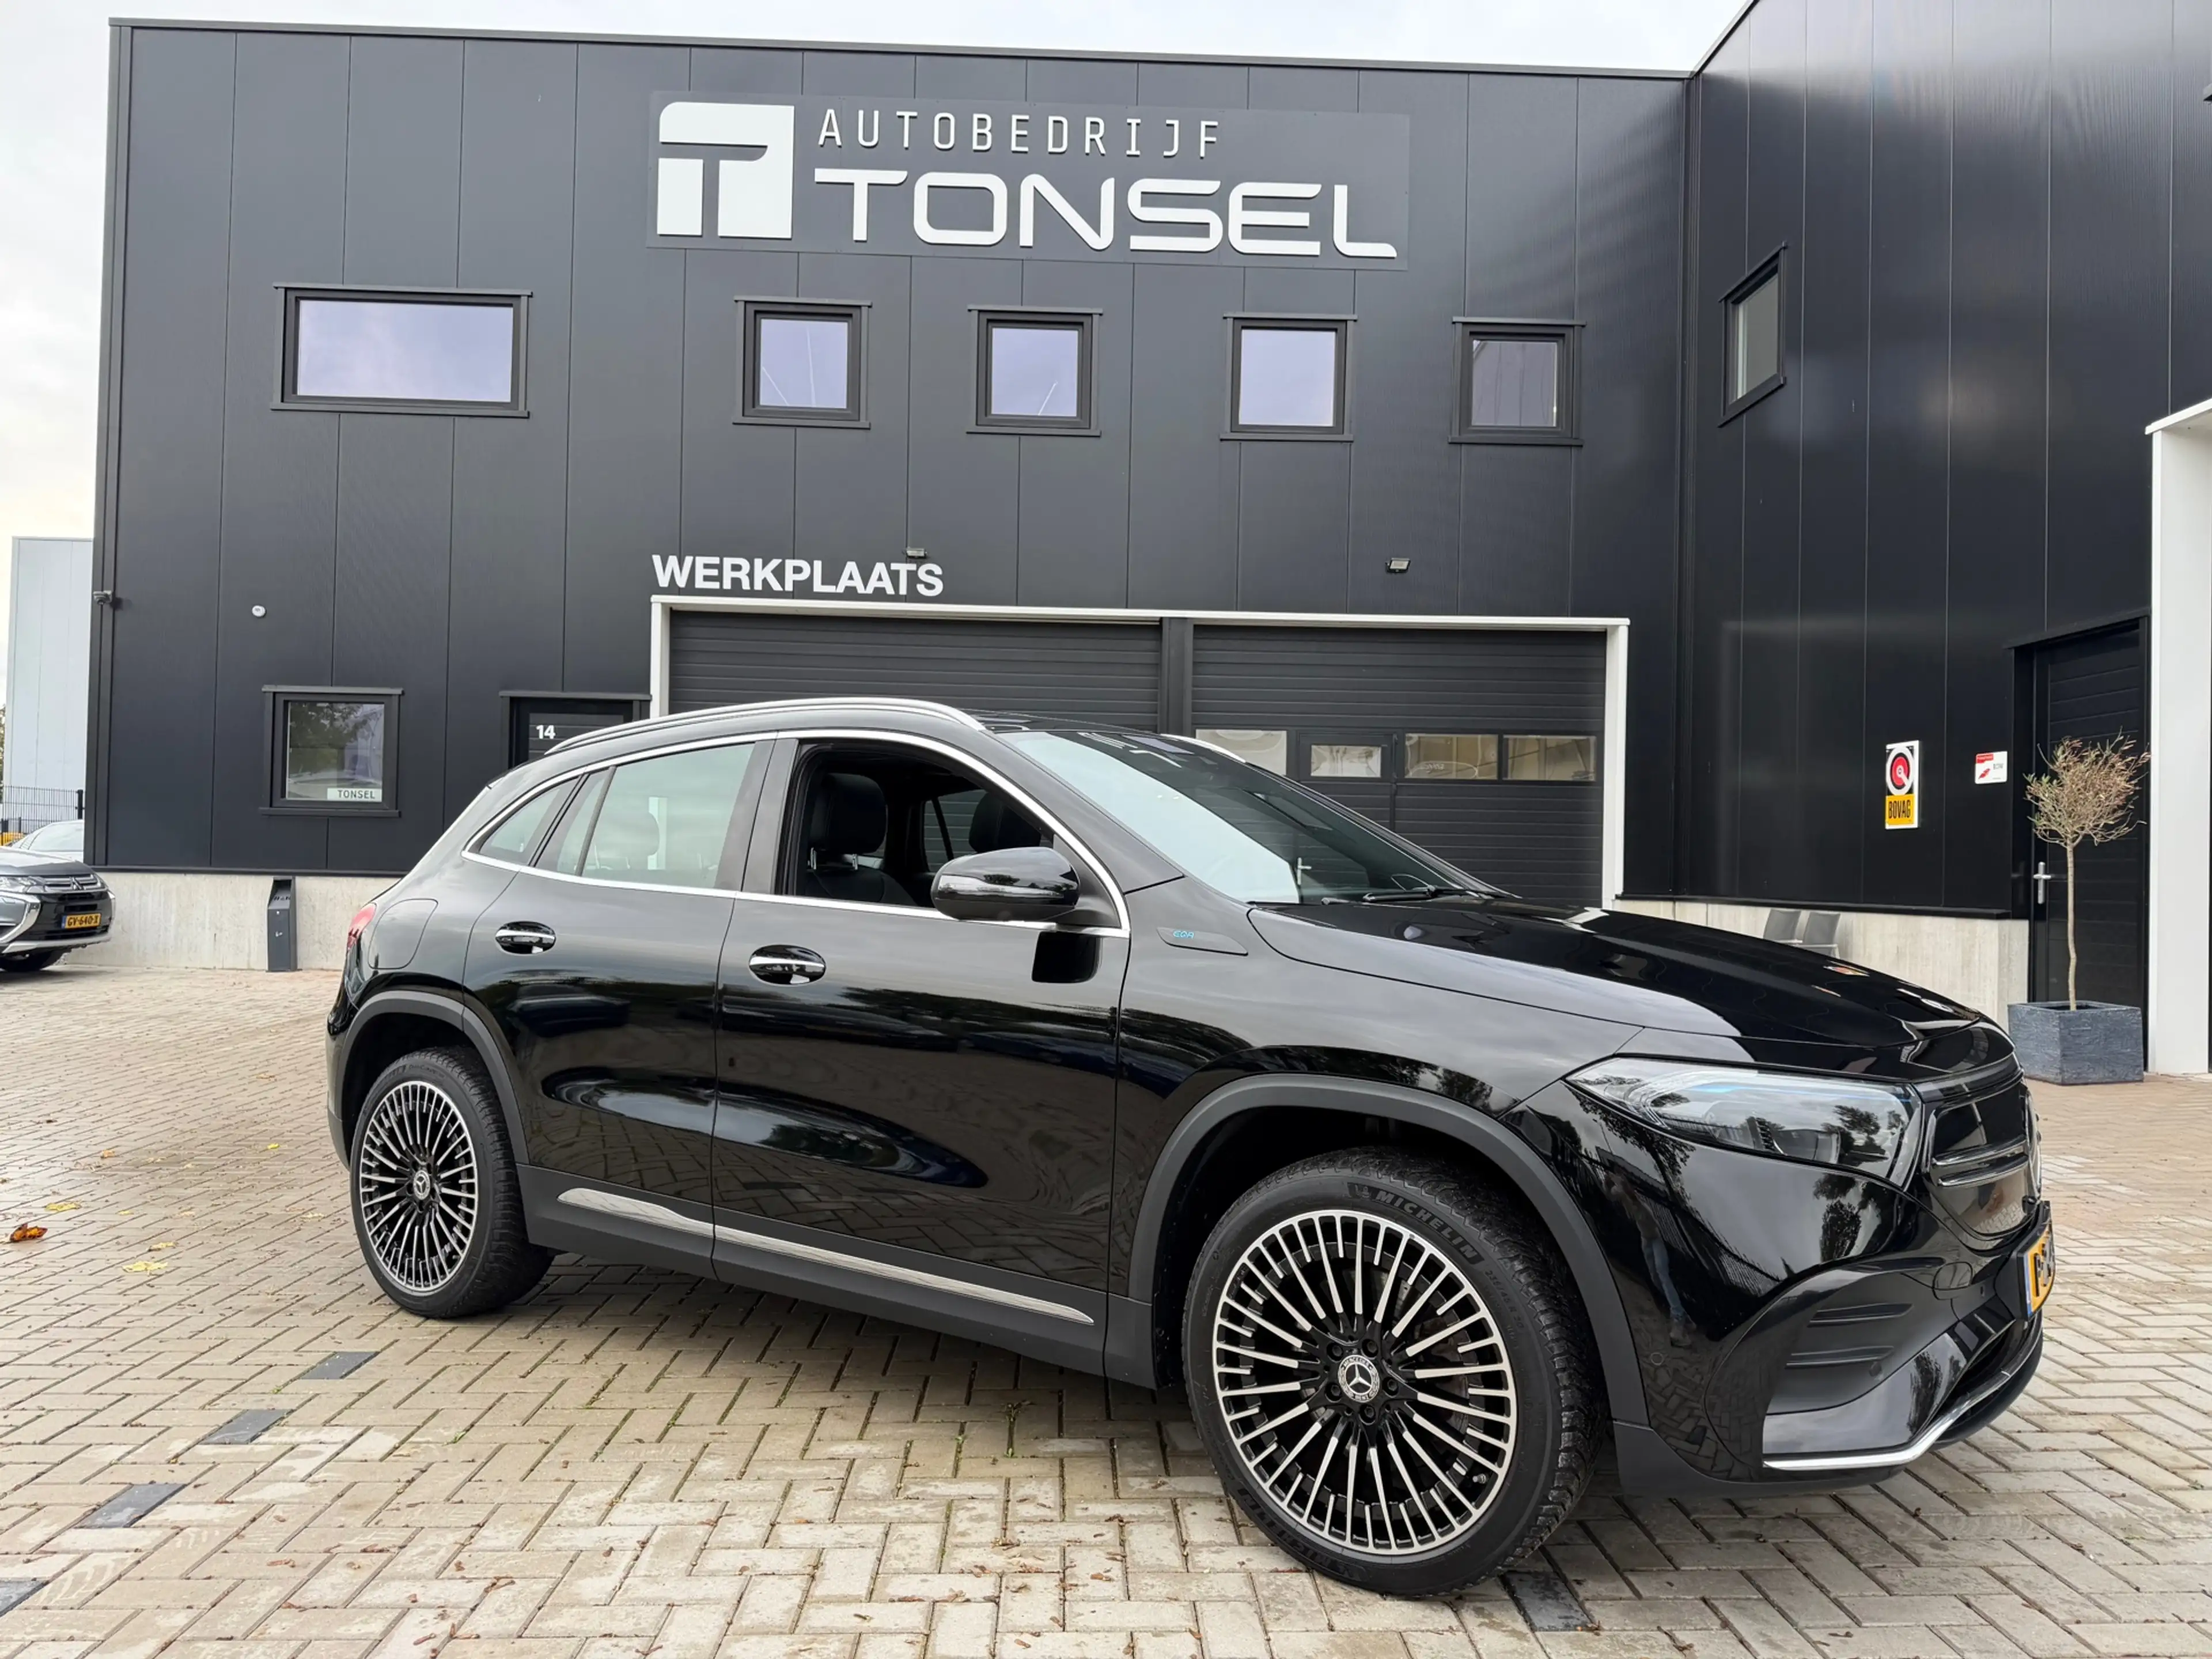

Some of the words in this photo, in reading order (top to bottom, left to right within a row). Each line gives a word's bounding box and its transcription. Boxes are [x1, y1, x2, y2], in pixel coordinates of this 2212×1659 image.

[817, 108, 1219, 158] AUTOBEDRIJF
[814, 168, 1397, 259] TONSEL
[652, 554, 944, 597] WERKPLAATS
[536, 725, 556, 740] 14
[337, 789, 376, 800] TONSEL
[1888, 800, 1911, 819] BOVAG
[1375, 1190, 1478, 1259] MICHELIN
